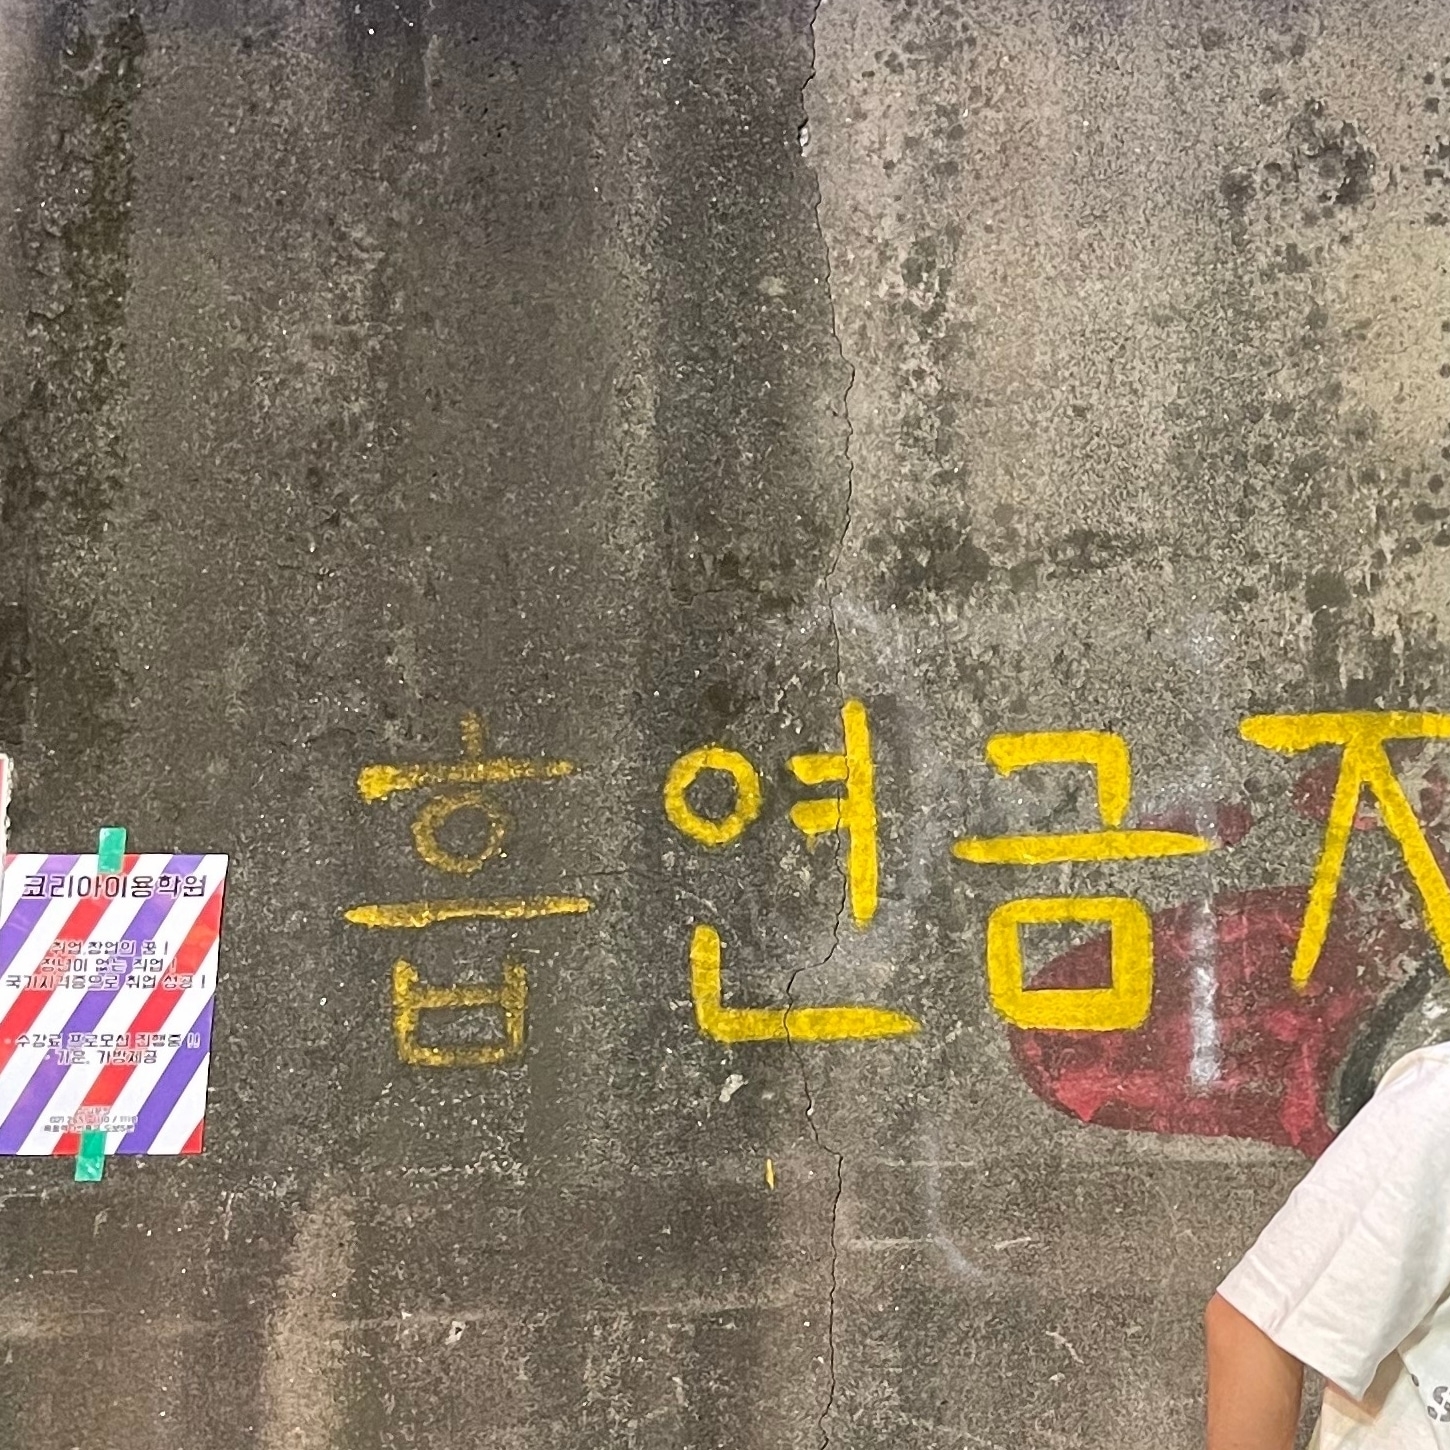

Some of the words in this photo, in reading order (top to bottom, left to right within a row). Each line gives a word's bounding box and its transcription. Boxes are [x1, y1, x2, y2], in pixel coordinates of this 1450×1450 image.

[22, 875, 207, 898] 코리아이용학원
[41, 958, 88, 972] 정년이
[95, 958, 126, 973] 없는
[133, 958, 164, 972] 직업
[126, 974, 157, 989] 취업
[163, 974, 193, 989] 성공
[68, 1033, 129, 1048] 프로모션
[136, 1033, 181, 1048] 진행중
[99, 1050, 157, 1064] 가방제공
